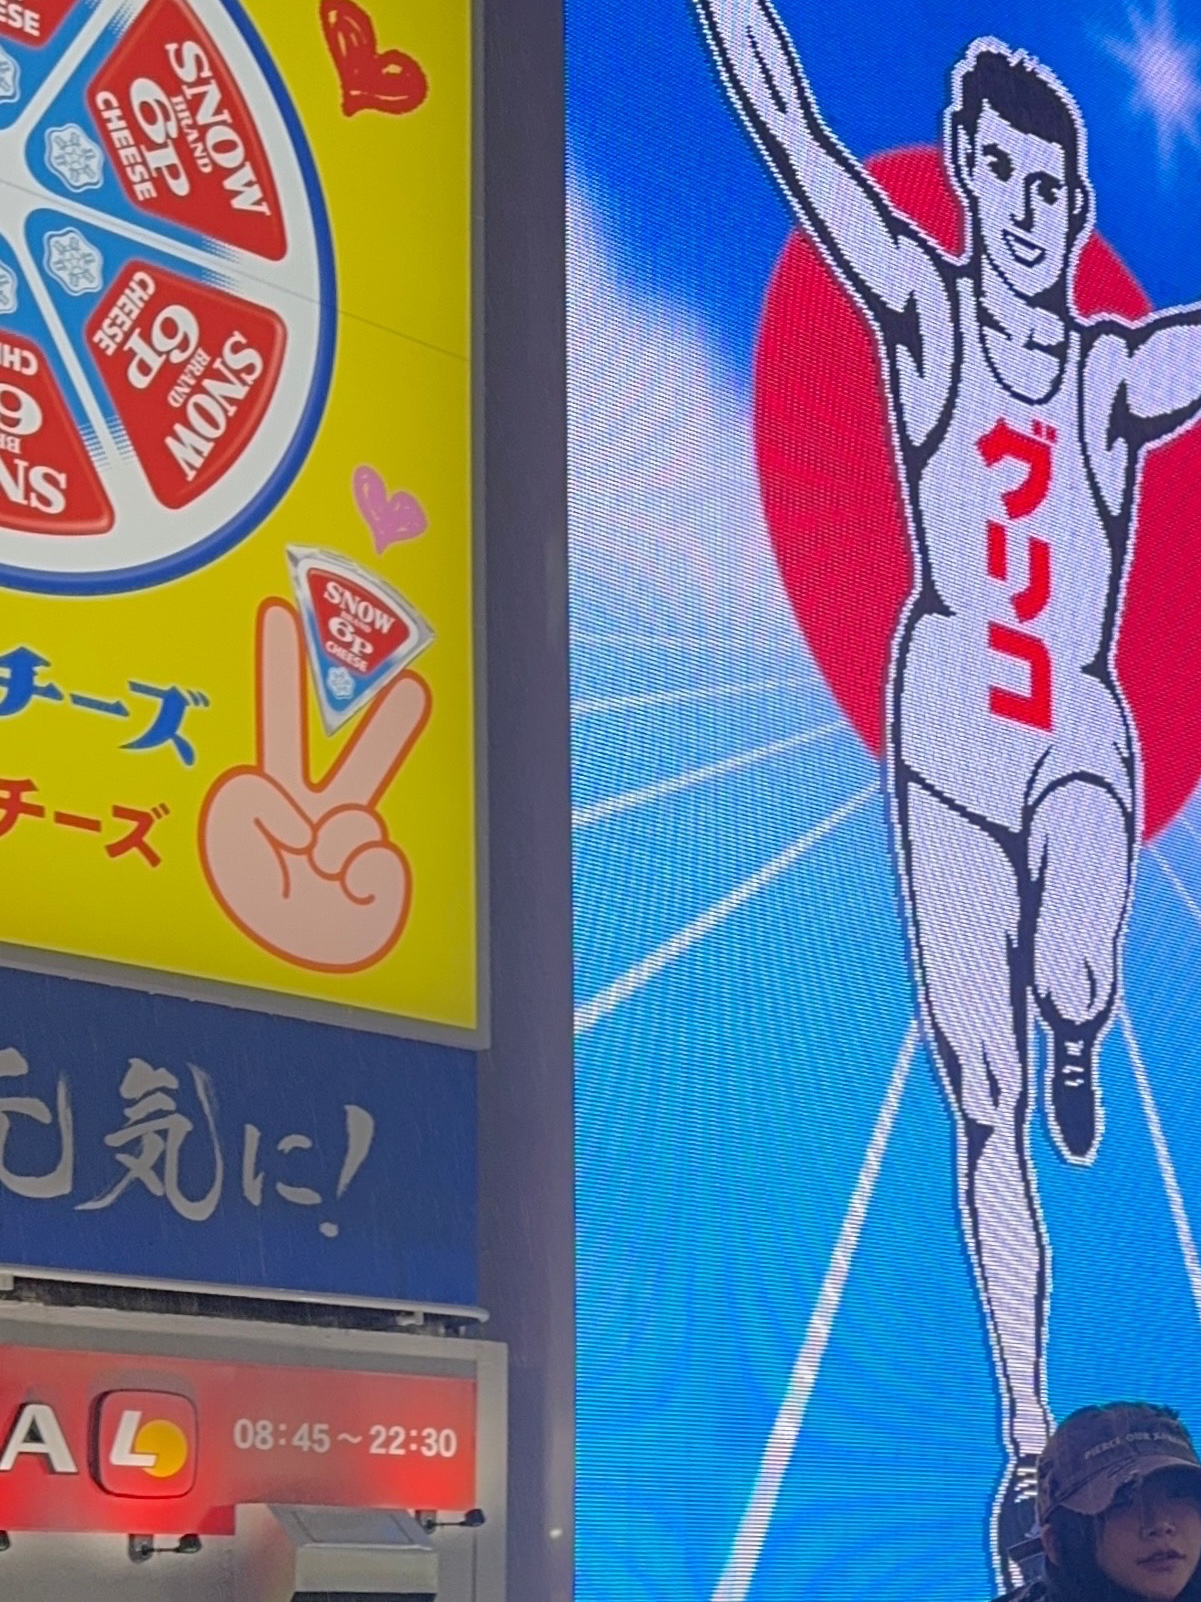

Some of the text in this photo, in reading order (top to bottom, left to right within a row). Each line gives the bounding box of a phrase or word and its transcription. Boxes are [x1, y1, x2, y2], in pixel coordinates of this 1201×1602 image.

[95, 90, 157, 201] CHEESE
[129, 77, 191, 198] 6P
[165, 40, 272, 217] SNOW
[170, 95, 213, 174] BRAND
[93, 271, 156, 355] CHEESE
[127, 305, 199, 389] 6P
[164, 331, 264, 482] SNOW
[168, 347, 211, 408] BRAND
[323, 581, 396, 634] SNOW
[975, 417, 1058, 734] グリコ
[325, 641, 369, 673] CHEESE
[328, 617, 374, 657] 6P
